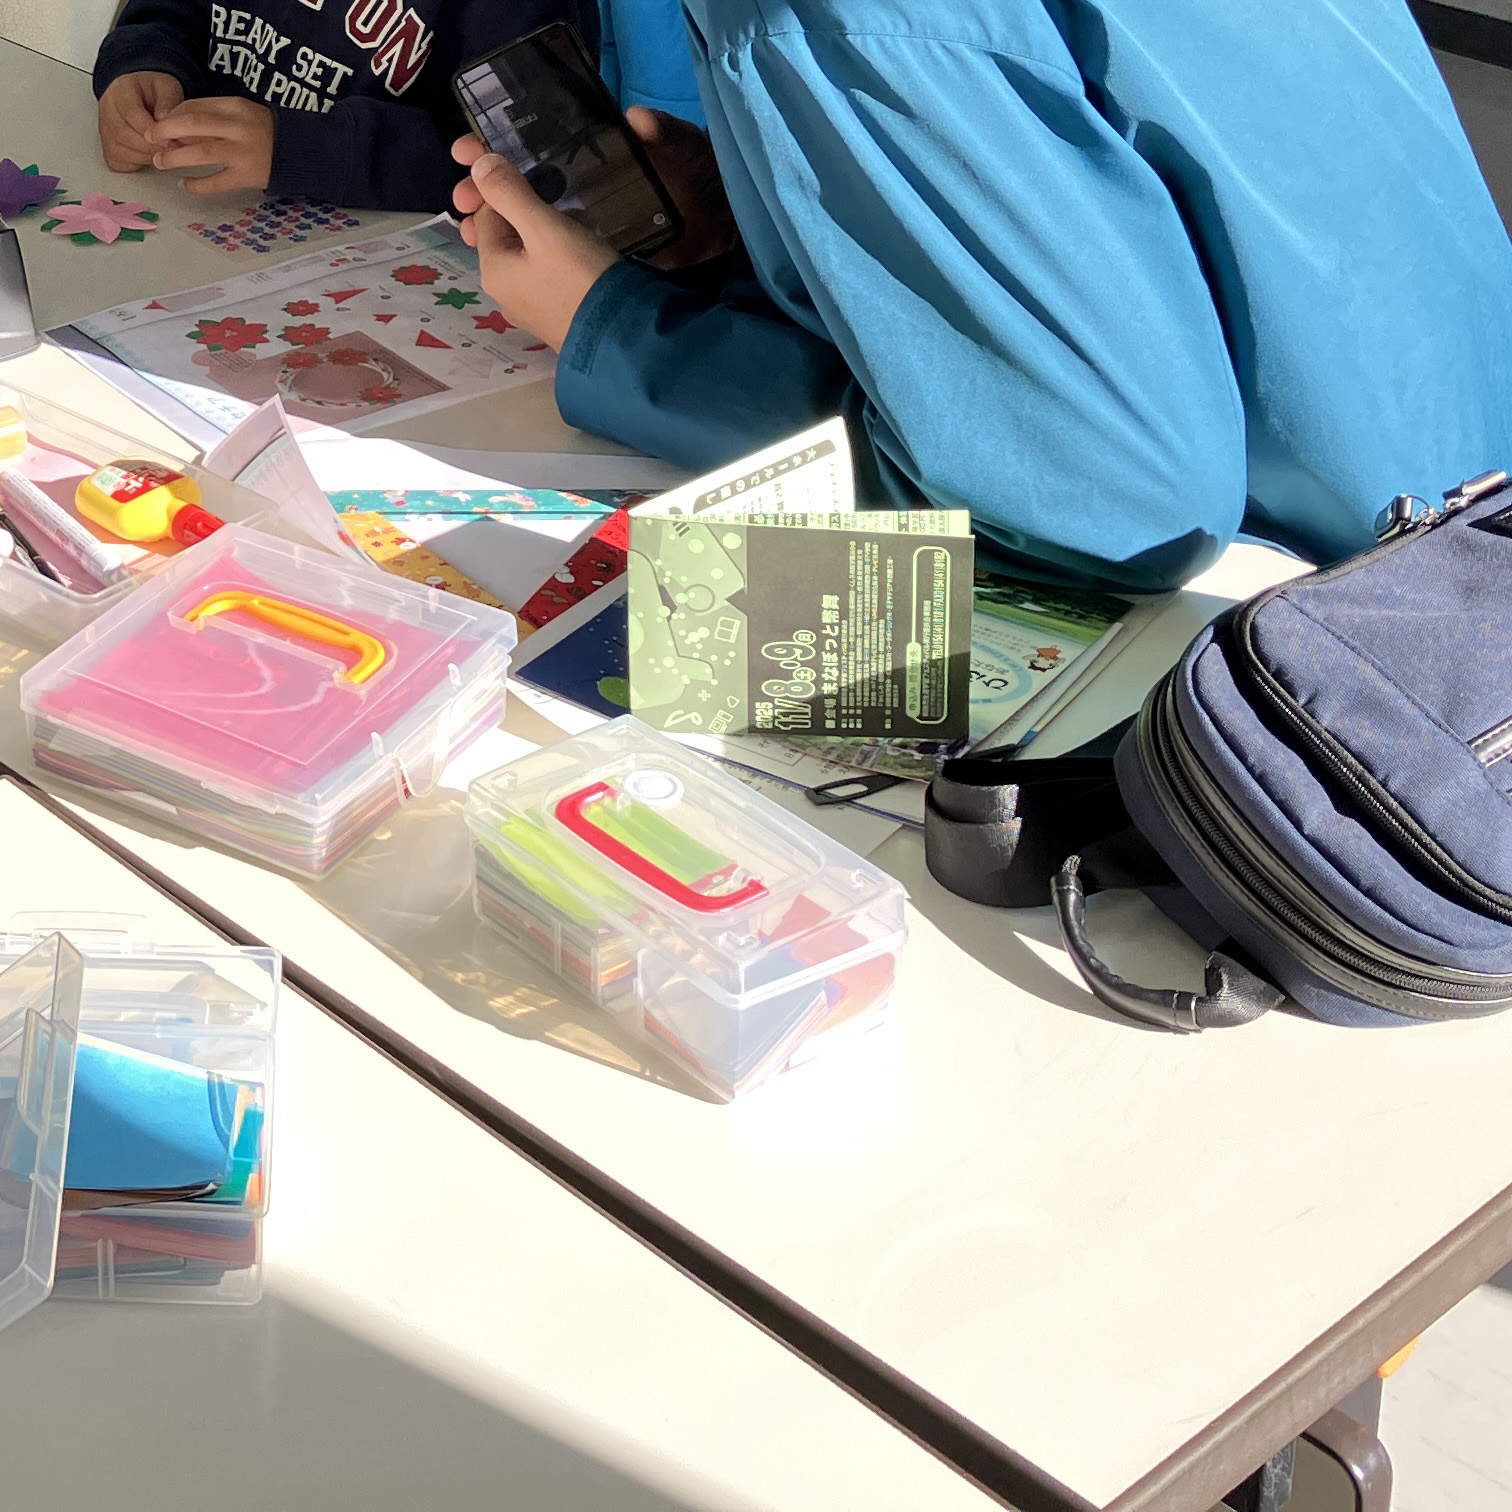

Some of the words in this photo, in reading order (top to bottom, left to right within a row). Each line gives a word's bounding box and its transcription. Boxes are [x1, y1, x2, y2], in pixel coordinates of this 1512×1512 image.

[208, 38, 266, 94] ATCH
[210, 2, 292, 65] READY
[292, 46, 354, 95] SET
[755, 701, 773, 729] 2025
